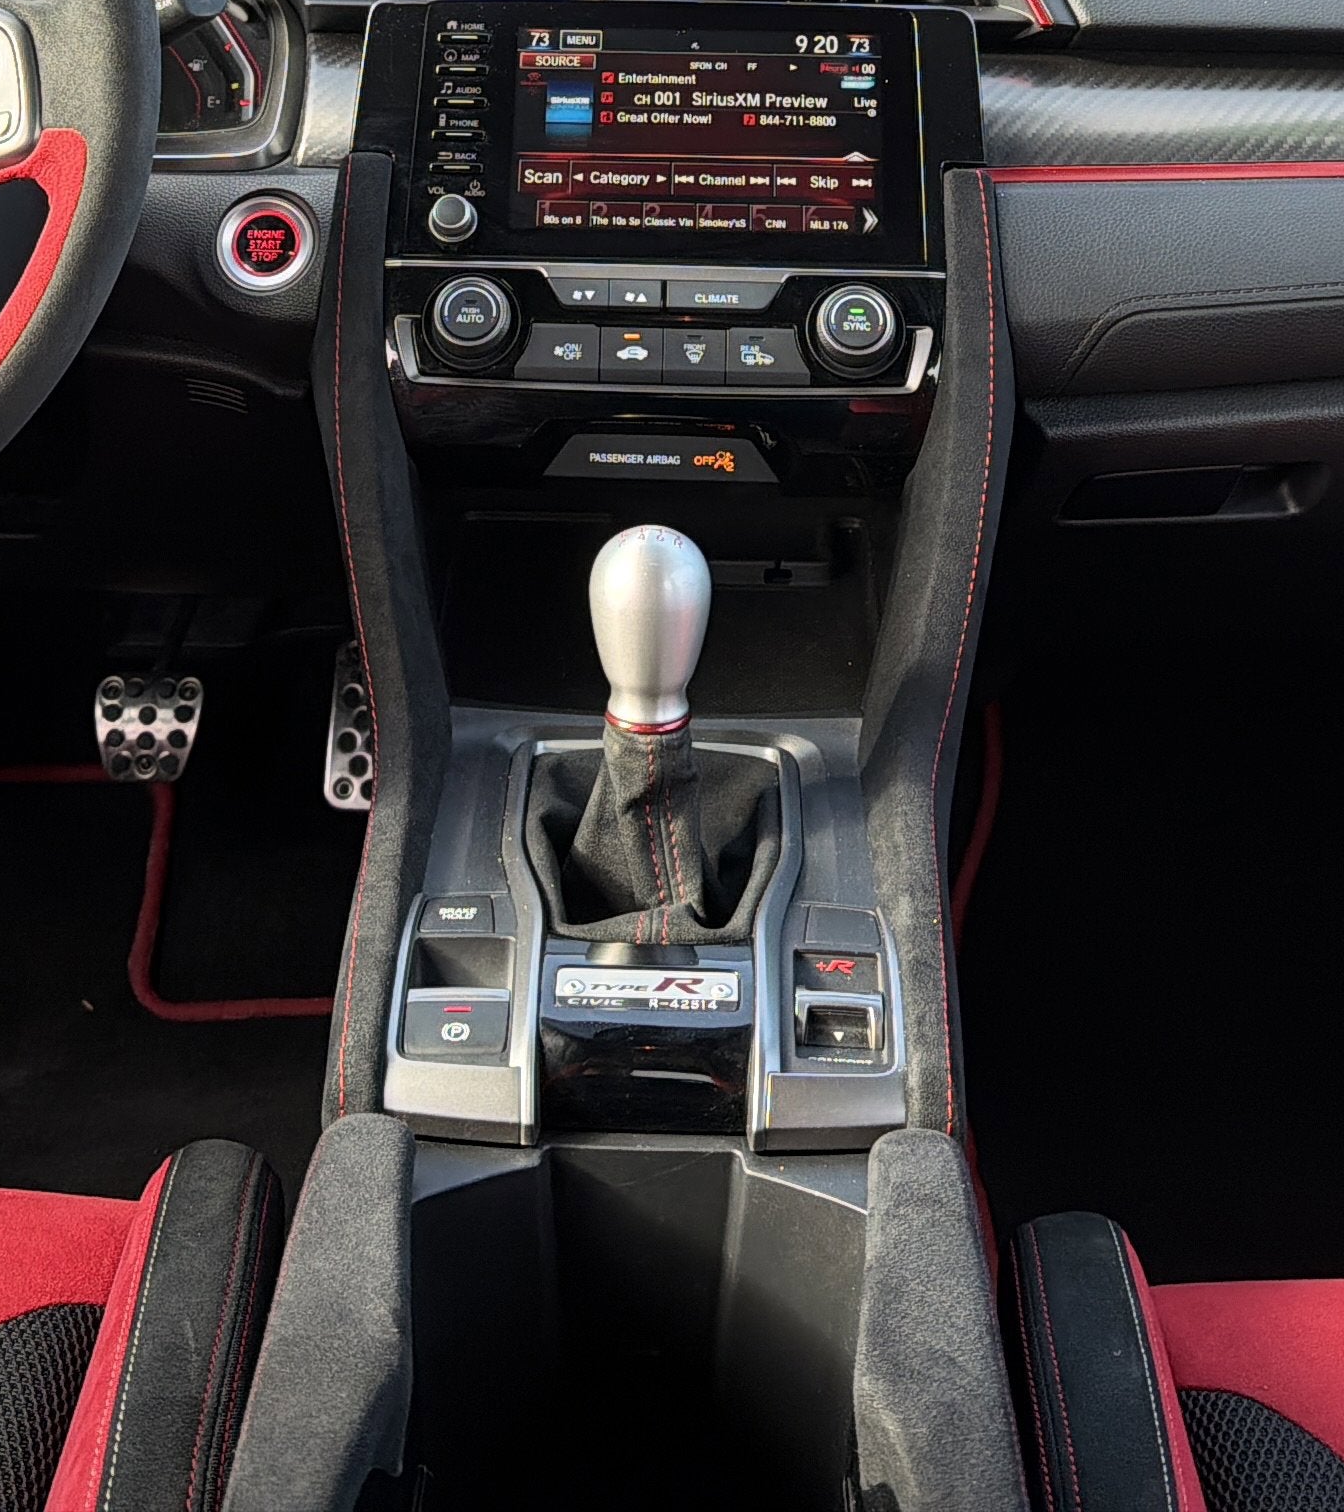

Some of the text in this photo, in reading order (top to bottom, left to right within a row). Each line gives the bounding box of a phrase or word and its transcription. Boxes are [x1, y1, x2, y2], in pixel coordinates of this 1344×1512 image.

[460, 23, 486, 31] HOME
[530, 32, 550, 47] 73
[566, 35, 596, 45] MENU
[850, 38, 870, 53] 73
[535, 56, 581, 67] SOURCE
[861, 64, 876, 75] 00
[618, 72, 696, 85] Entertainment
[455, 86, 482, 94] AUDIO
[634, 91, 828, 109] CH 001 SiriusXM Preview
[853, 96, 878, 108] Live
[449, 119, 480, 127] PHONE
[616, 112, 712, 125] Great Offer Now!
[759, 114, 837, 127] 844-711-8800
[454, 152, 478, 160] BACK
[524, 169, 563, 184] Scan
[589, 171, 651, 186] Category
[698, 173, 746, 186] Channel
[810, 175, 839, 190] Skip
[427, 186, 446, 195] VOL
[543, 215, 560, 225] 80s
[561, 217, 574, 225] on
[591, 216, 609, 226] The
[629, 216, 641, 228] Sp
[644, 217, 694, 227] Classic Vin
[765, 219, 787, 229] CNN
[810, 220, 849, 230] MLB 176
[247, 230, 285, 239] ENGINE
[249, 240, 281, 249] START
[251, 251, 278, 262] STOP
[694, 293, 740, 304] CLIMATE
[456, 314, 485, 323] AUTO
[843, 321, 872, 331] SYNC
[563, 343, 583, 352] ON/
[683, 343, 706, 351] FRONT
[740, 344, 761, 352] REAR
[563, 351, 583, 361] OFF
[589, 453, 681, 465] PASSENGER AIRBAG
[693, 455, 715, 466] OFF
[439, 907, 478, 915] BRAKE
[441, 913, 475, 921] HOLD
[590, 976, 705, 995] TYPE R
[567, 997, 625, 1007] CIVIC
